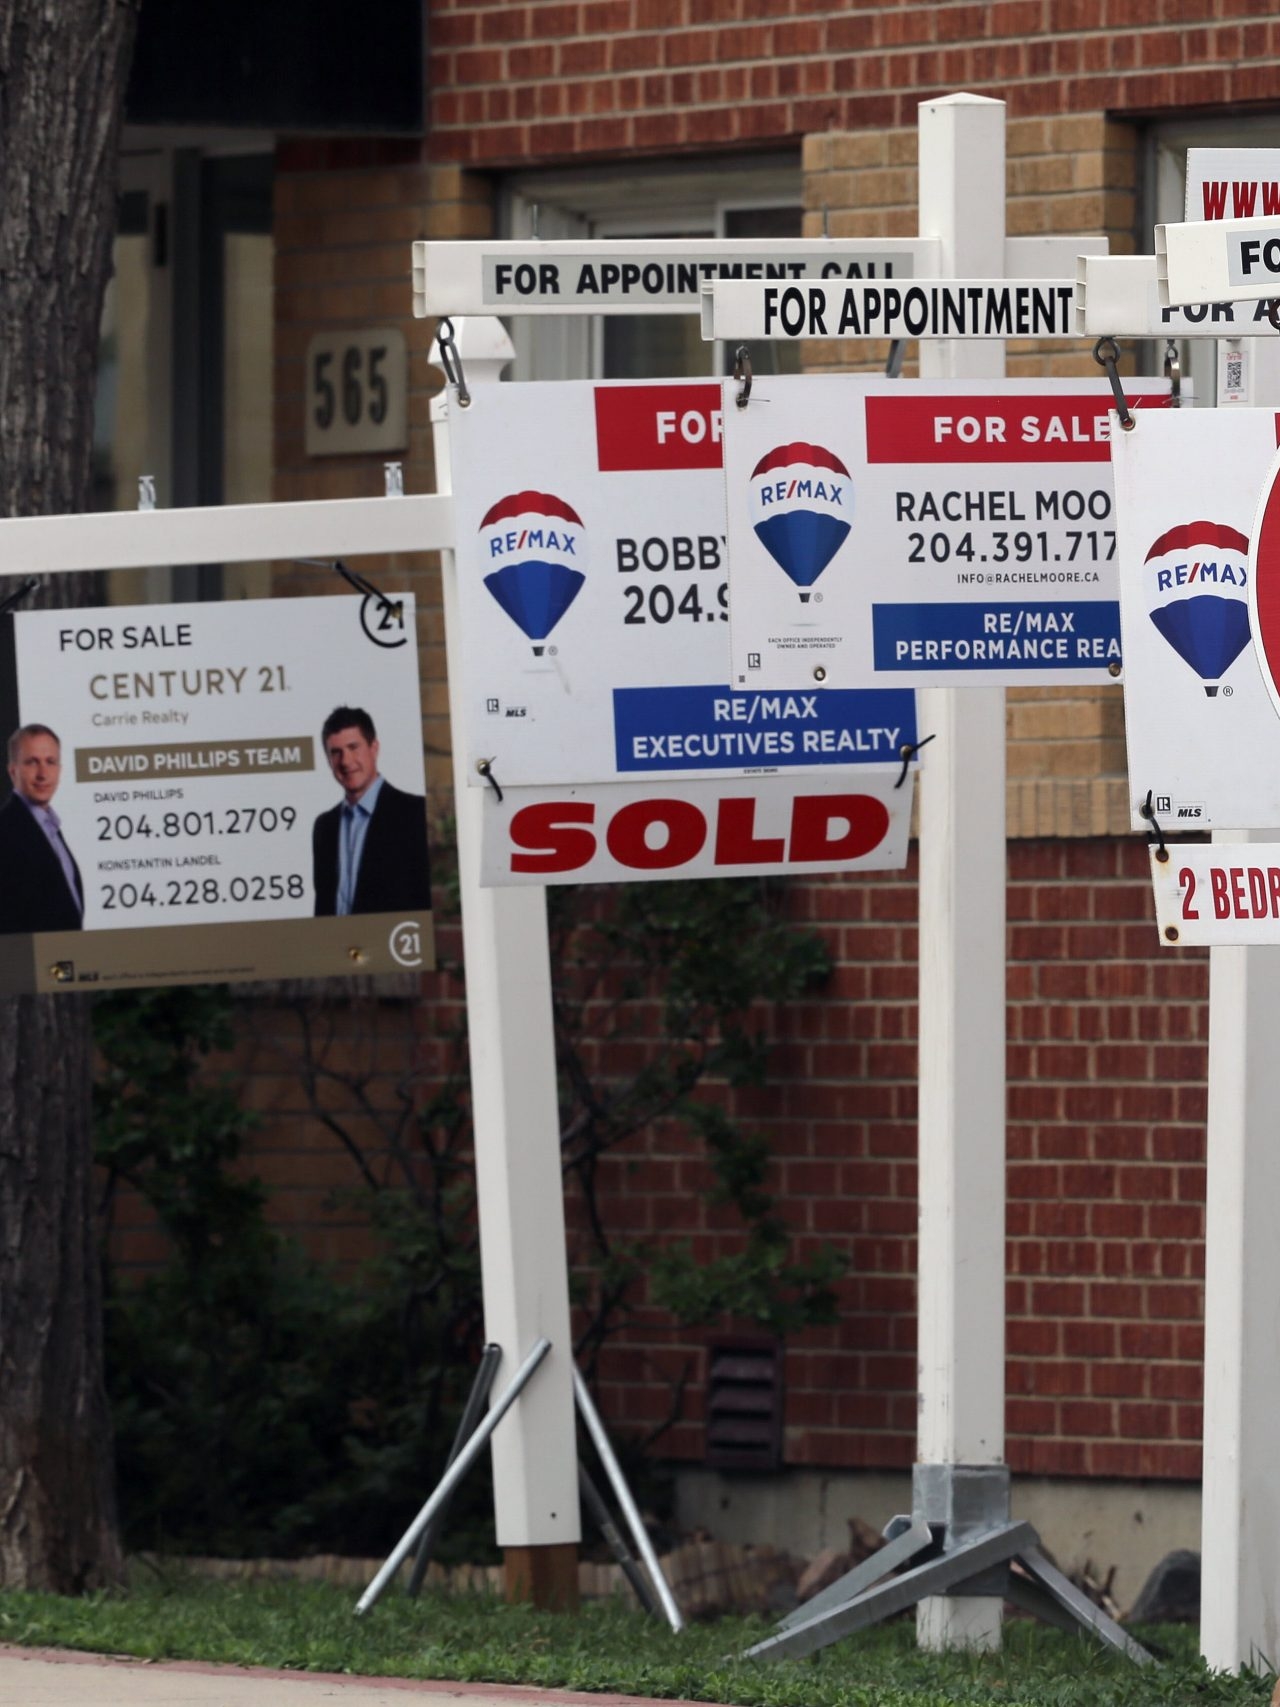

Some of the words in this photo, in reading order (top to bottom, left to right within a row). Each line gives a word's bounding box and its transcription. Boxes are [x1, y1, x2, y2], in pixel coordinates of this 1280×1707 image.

[495, 264, 560, 294] FOR
[576, 263, 806, 294] APPOINTMENT
[764, 286, 828, 336] FOR
[837, 286, 1073, 336] APPOINTMENT
[314, 346, 388, 430] 565
[934, 416, 1007, 444] FOR
[1021, 416, 1111, 443] SALE
[761, 479, 843, 506] RE/MAX
[896, 490, 1025, 522] RACHEL
[1035, 490, 1112, 521] MOO
[490, 529, 576, 557] RE/MAX
[616, 535, 726, 573] BOBB
[908, 531, 1117, 563] 204.391.717
[957, 571, 1100, 584] INFO@RACHELMOORE.CA
[984, 611, 1075, 634] RE/MAX
[59, 627, 115, 652] FOR
[123, 624, 193, 649] SALE
[896, 638, 1068, 661] PERFORMANCE
[1077, 638, 1122, 659] REA
[89, 667, 249, 700] CENTURY
[92, 711, 138, 728] Carrie
[143, 710, 190, 727] Realty
[505, 708, 527, 717] MLS
[714, 696, 818, 722] RE/MAX
[632, 731, 795, 759] EXECUTIVES
[803, 728, 900, 753] REALTY
[88, 753, 149, 775] DAVID
[153, 748, 240, 772] PHILLIPS
[246, 745, 301, 767] TEAM
[94, 791, 130, 803] DAVID
[133, 788, 184, 800] PHILLIPS
[97, 806, 297, 841] 204.801.2709
[1177, 808, 1202, 818] MLS
[509, 794, 890, 874] SOLD
[175, 854, 221, 868] LANDEL
[102, 873, 305, 910] 204.228.0258
[1179, 866, 1199, 920] 2
